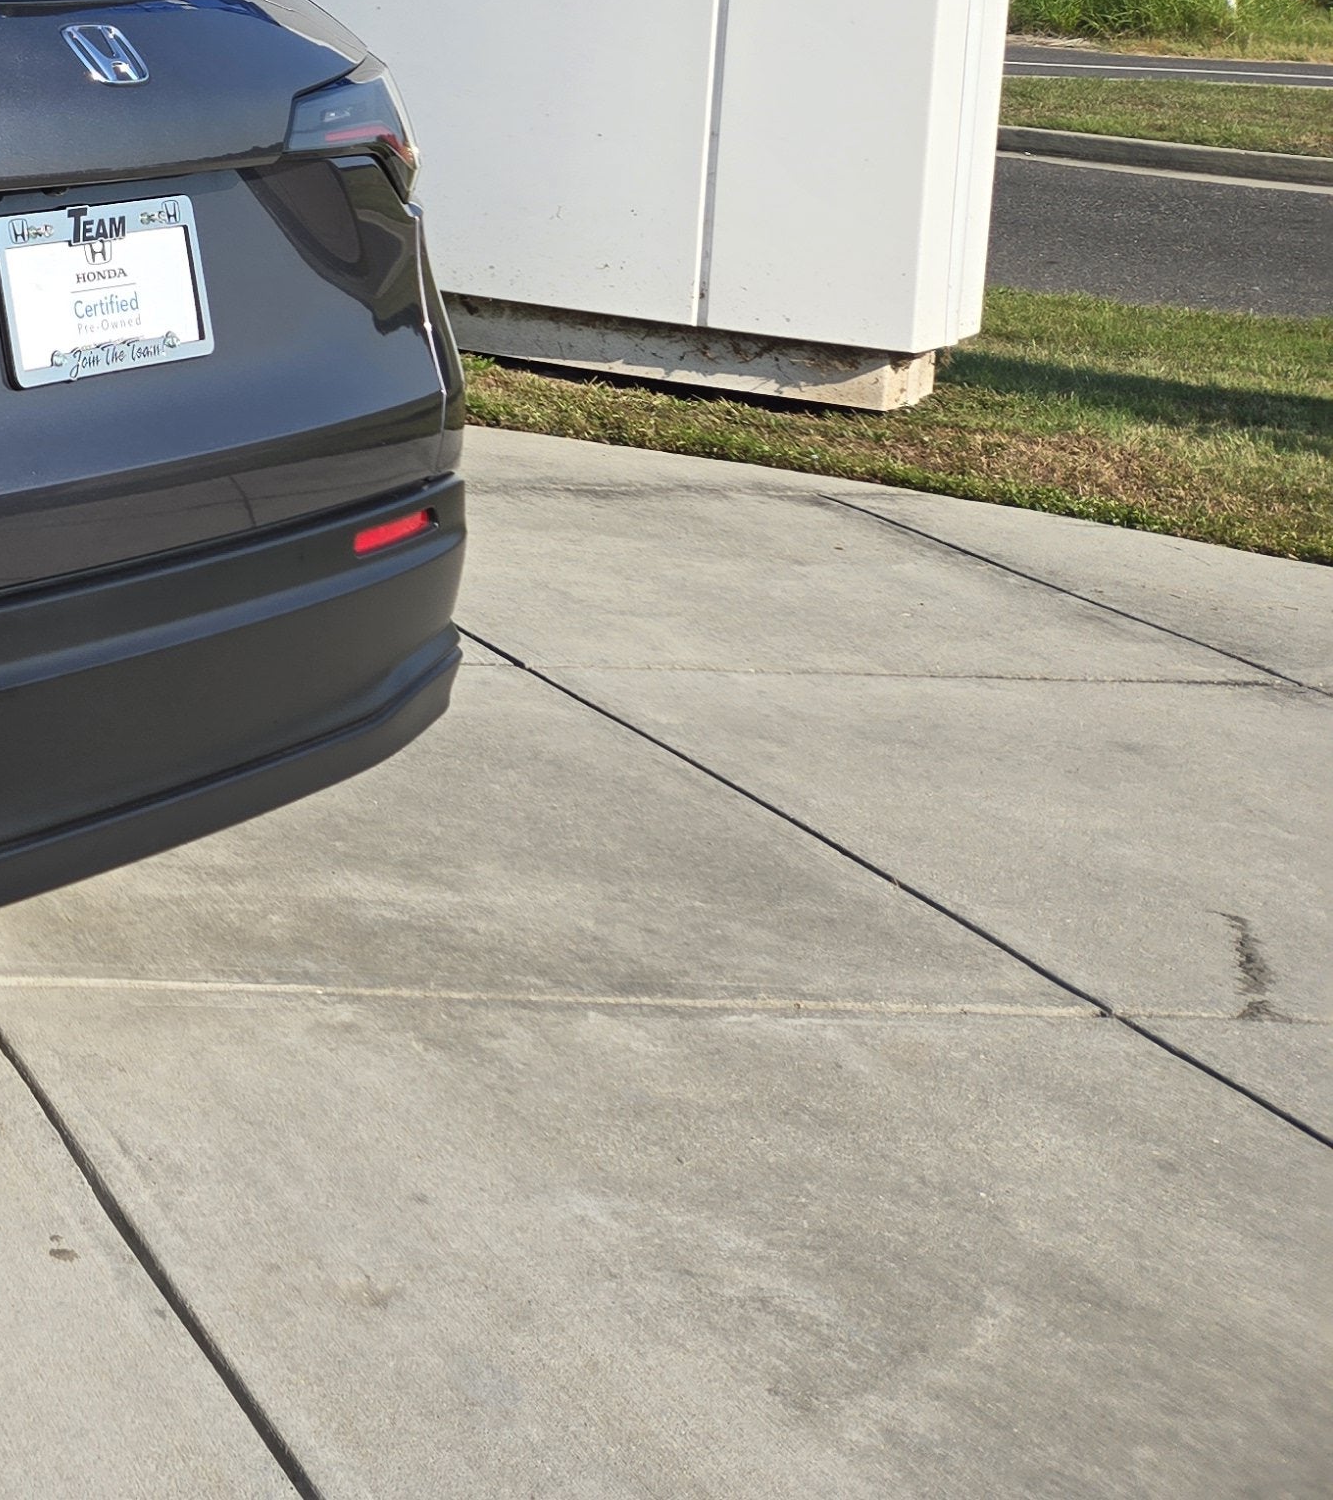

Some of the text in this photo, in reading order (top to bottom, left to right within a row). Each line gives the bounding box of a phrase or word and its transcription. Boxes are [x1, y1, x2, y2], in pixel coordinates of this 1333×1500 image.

[67, 206, 127, 244] TEAM
[75, 267, 129, 284] HONDA
[73, 291, 140, 320] Certified
[77, 314, 142, 335] Pre-Owned
[69, 349, 101, 378] Join
[101, 343, 126, 366] The
